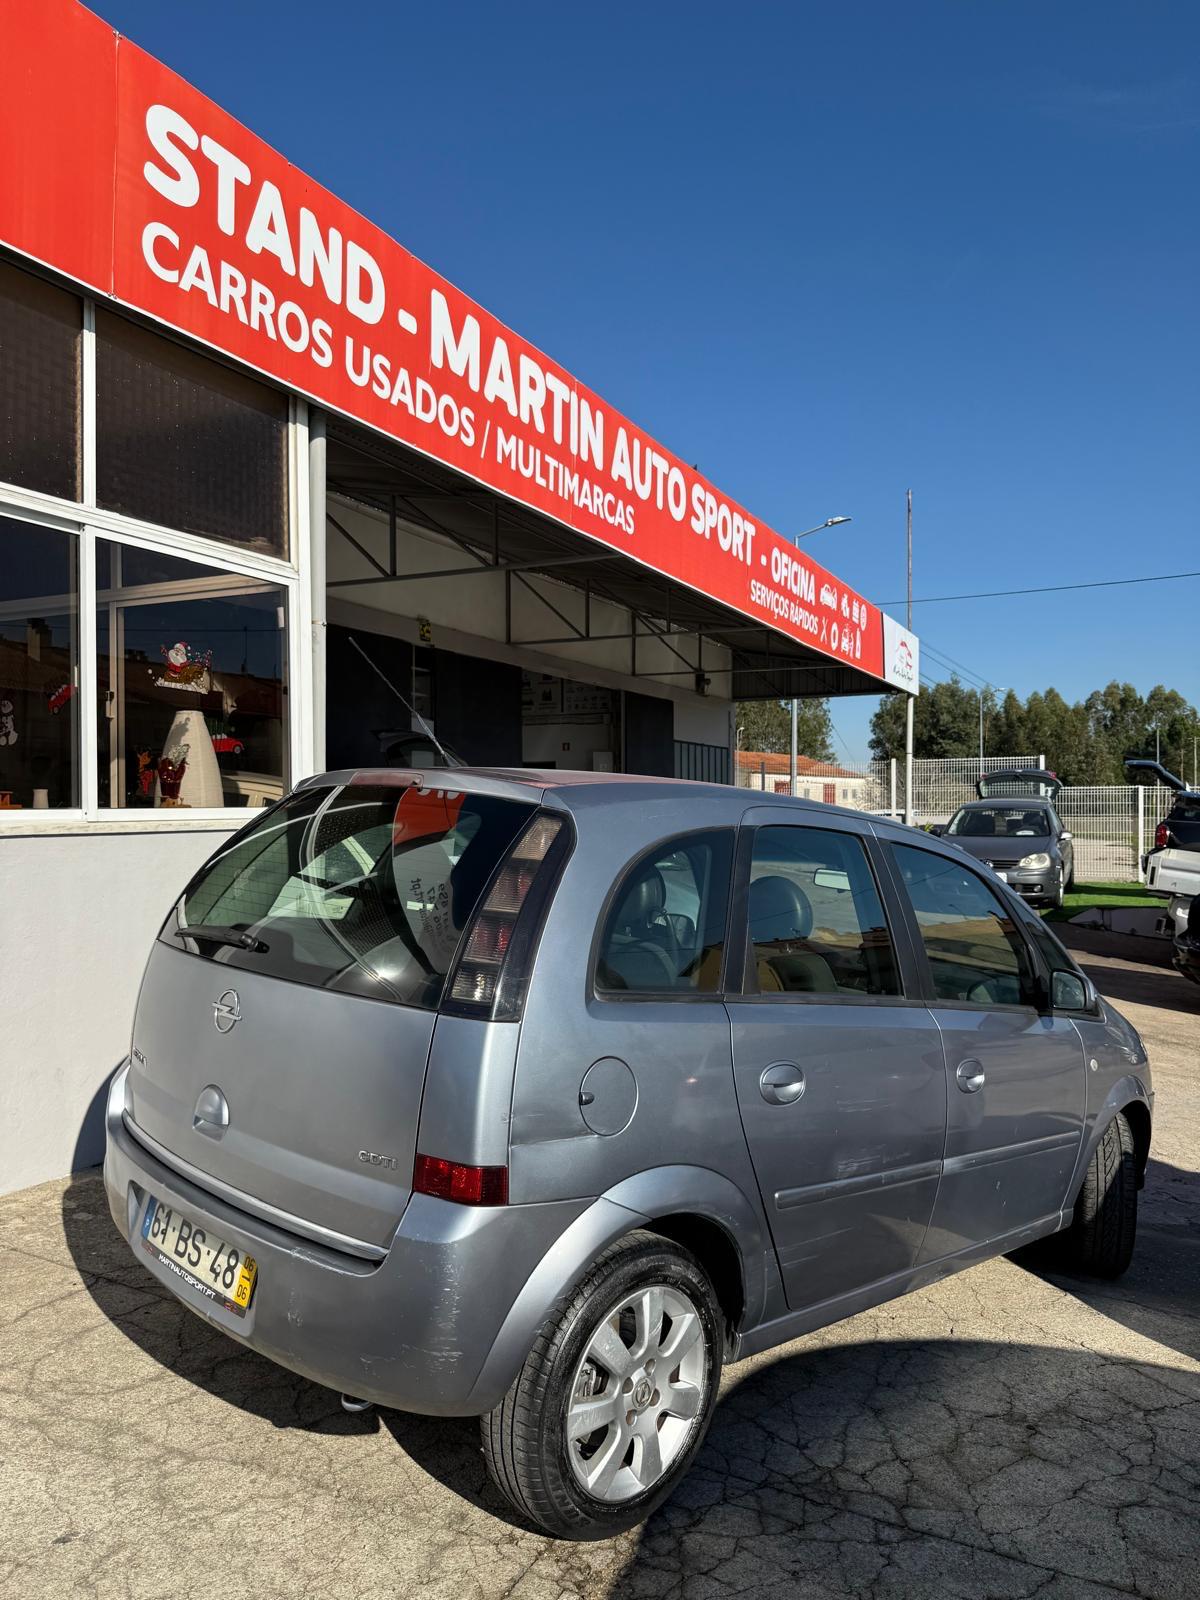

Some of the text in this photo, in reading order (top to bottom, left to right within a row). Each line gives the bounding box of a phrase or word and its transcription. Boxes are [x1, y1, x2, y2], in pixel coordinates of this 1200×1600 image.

[141, 221, 334, 368] CARROS
[345, 335, 476, 447] USADOS
[496, 426, 635, 535] MULTIMARCAS
[143, 104, 386, 325] STAND
[430, 288, 604, 471] MARTIN
[611, 426, 686, 521] AUTO
[691, 483, 756, 566] SPORT
[771, 547, 816, 606] OFICINA
[750, 579, 819, 635] SERVIÇOS RÁPIDOS
[358, 1150, 397, 1170] CDTI
[158, 1253, 216, 1300] MARTINAUTOSPORT.PT
